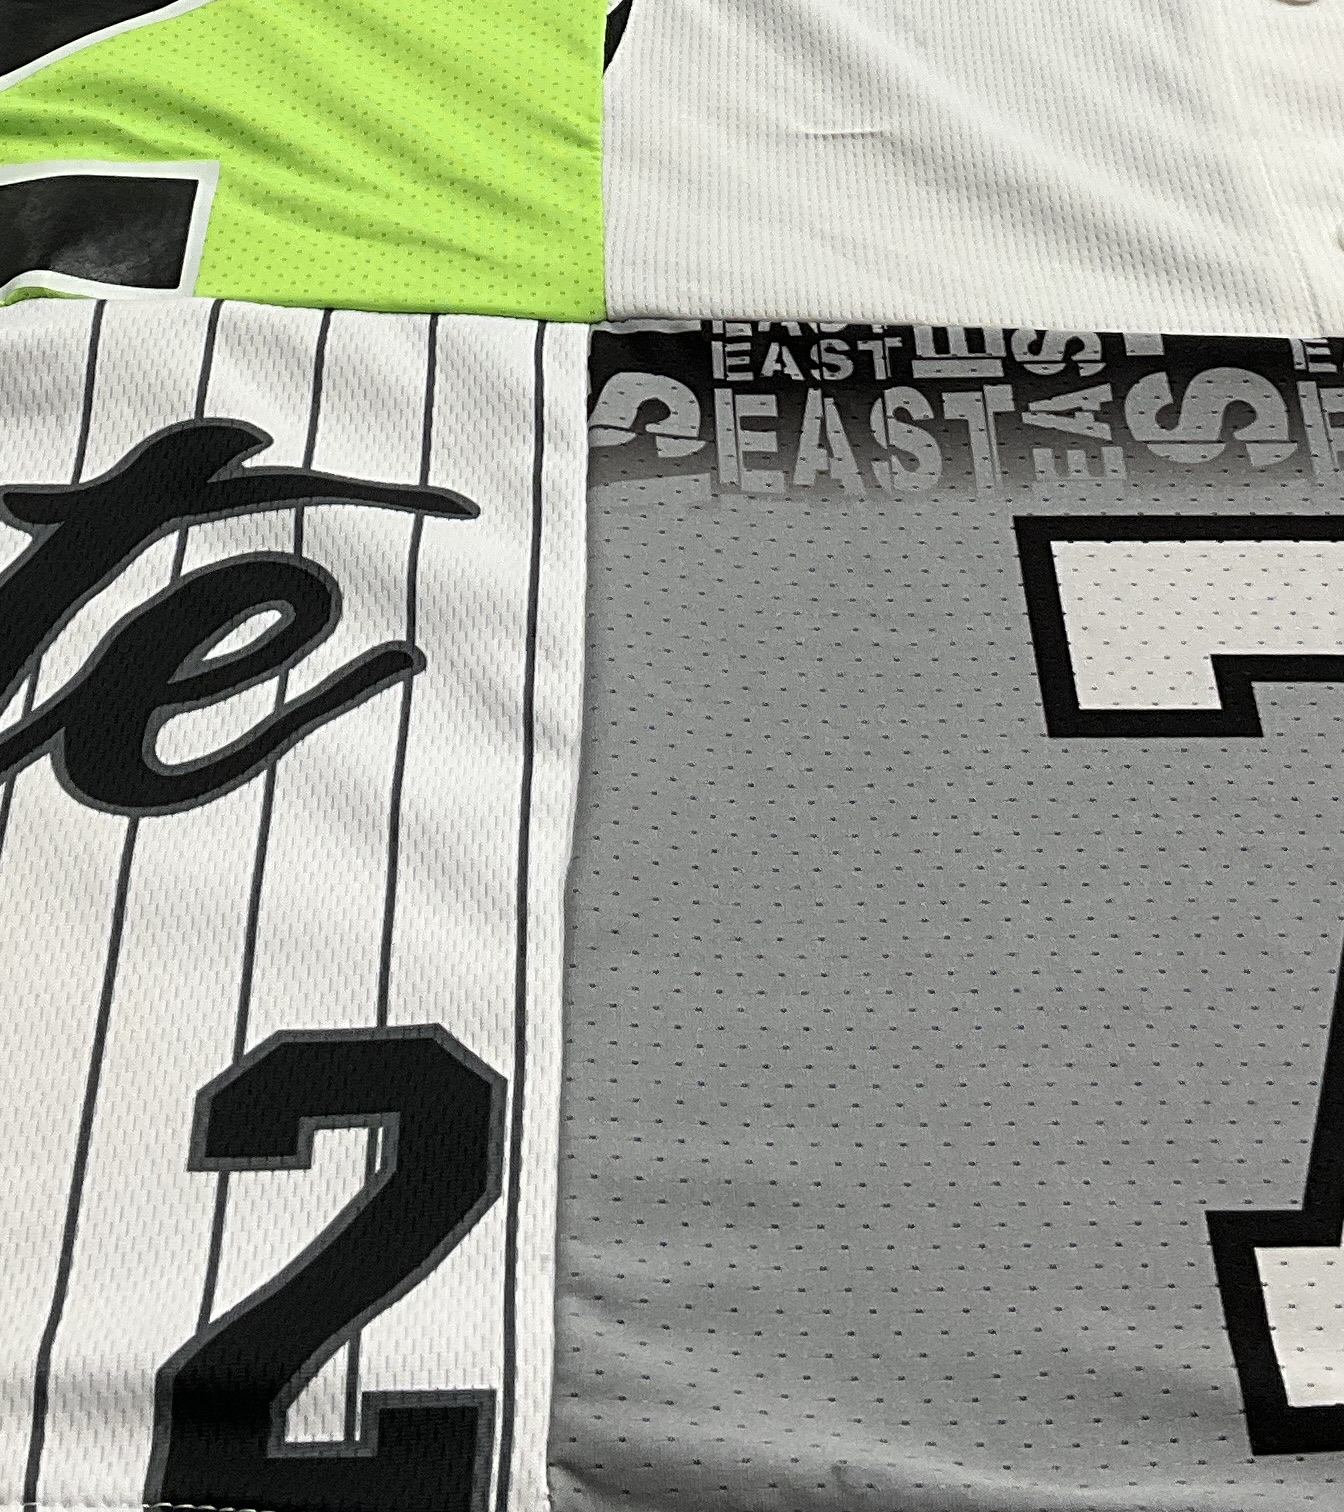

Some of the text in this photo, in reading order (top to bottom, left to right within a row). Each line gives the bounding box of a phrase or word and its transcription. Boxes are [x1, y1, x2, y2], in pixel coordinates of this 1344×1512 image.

[711, 337, 903, 381] EAST
[713, 385, 1016, 493] EAST
[144, 1023, 508, 1512] 2
